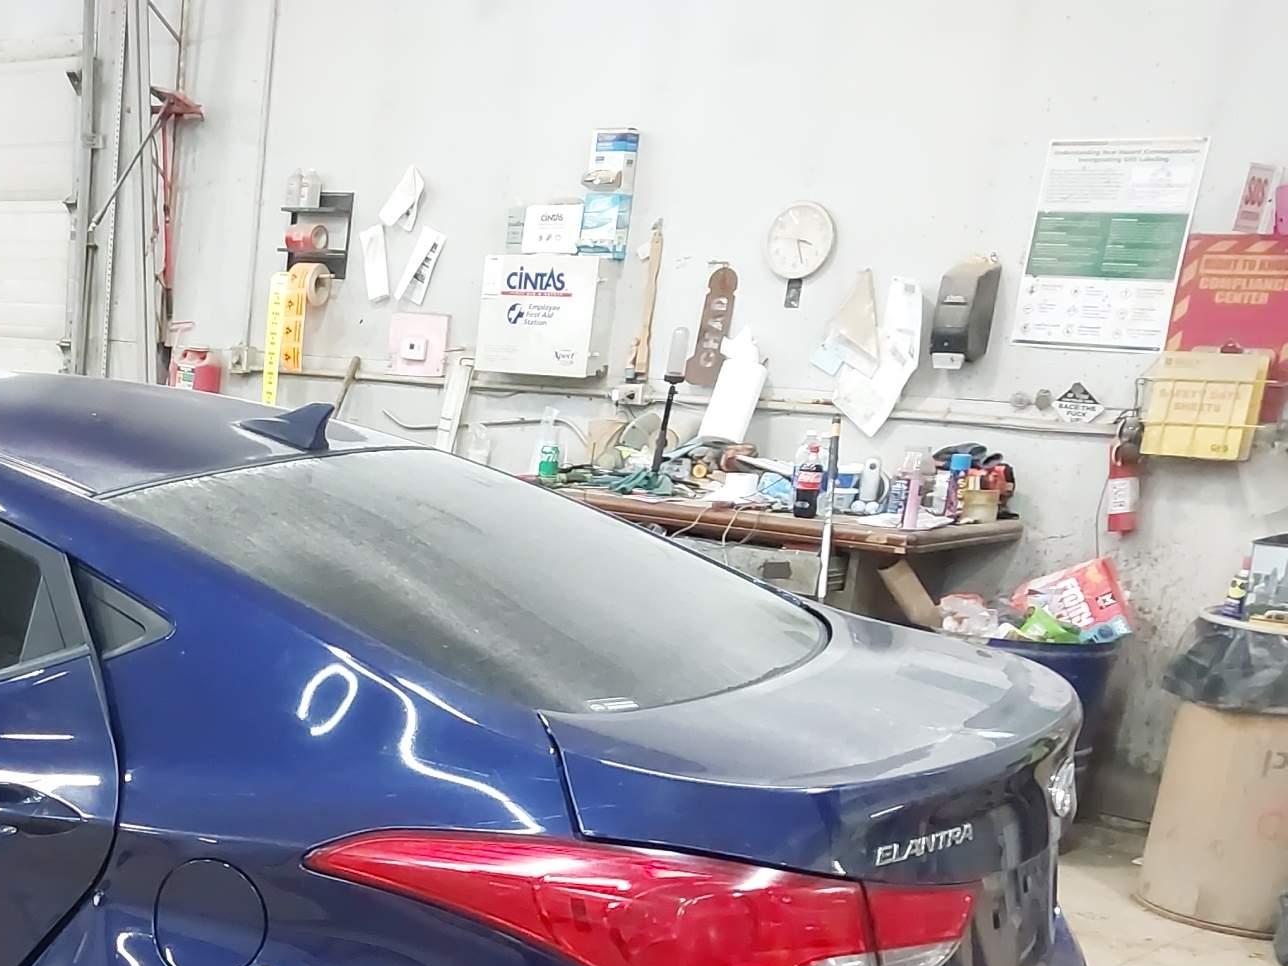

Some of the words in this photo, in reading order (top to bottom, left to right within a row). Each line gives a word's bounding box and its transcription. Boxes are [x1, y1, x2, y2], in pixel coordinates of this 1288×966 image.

[506, 266, 566, 291] CINTAS
[1214, 291, 1270, 305] CENTER
[875, 822, 974, 867] ELANTRA
